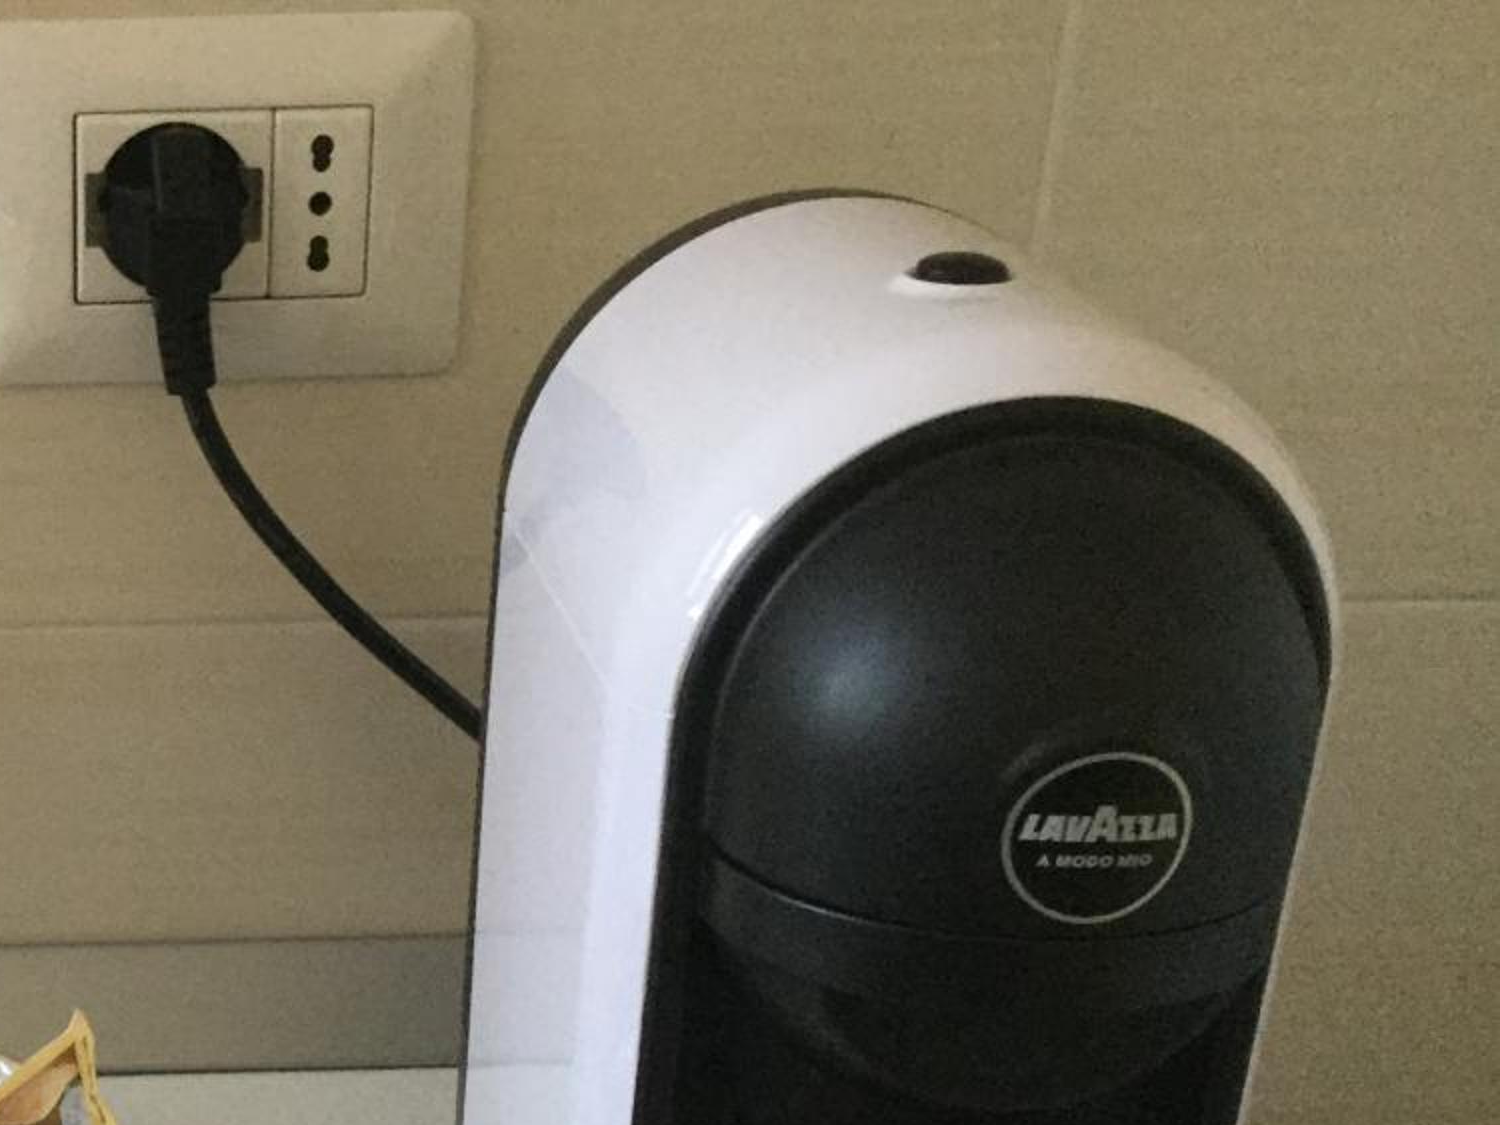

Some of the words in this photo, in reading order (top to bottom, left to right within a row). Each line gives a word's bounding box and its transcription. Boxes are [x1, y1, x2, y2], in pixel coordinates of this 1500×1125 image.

[1018, 804, 1178, 843] LAVAZZA
[1035, 854, 1050, 867] A
[1055, 854, 1113, 868] MODO
